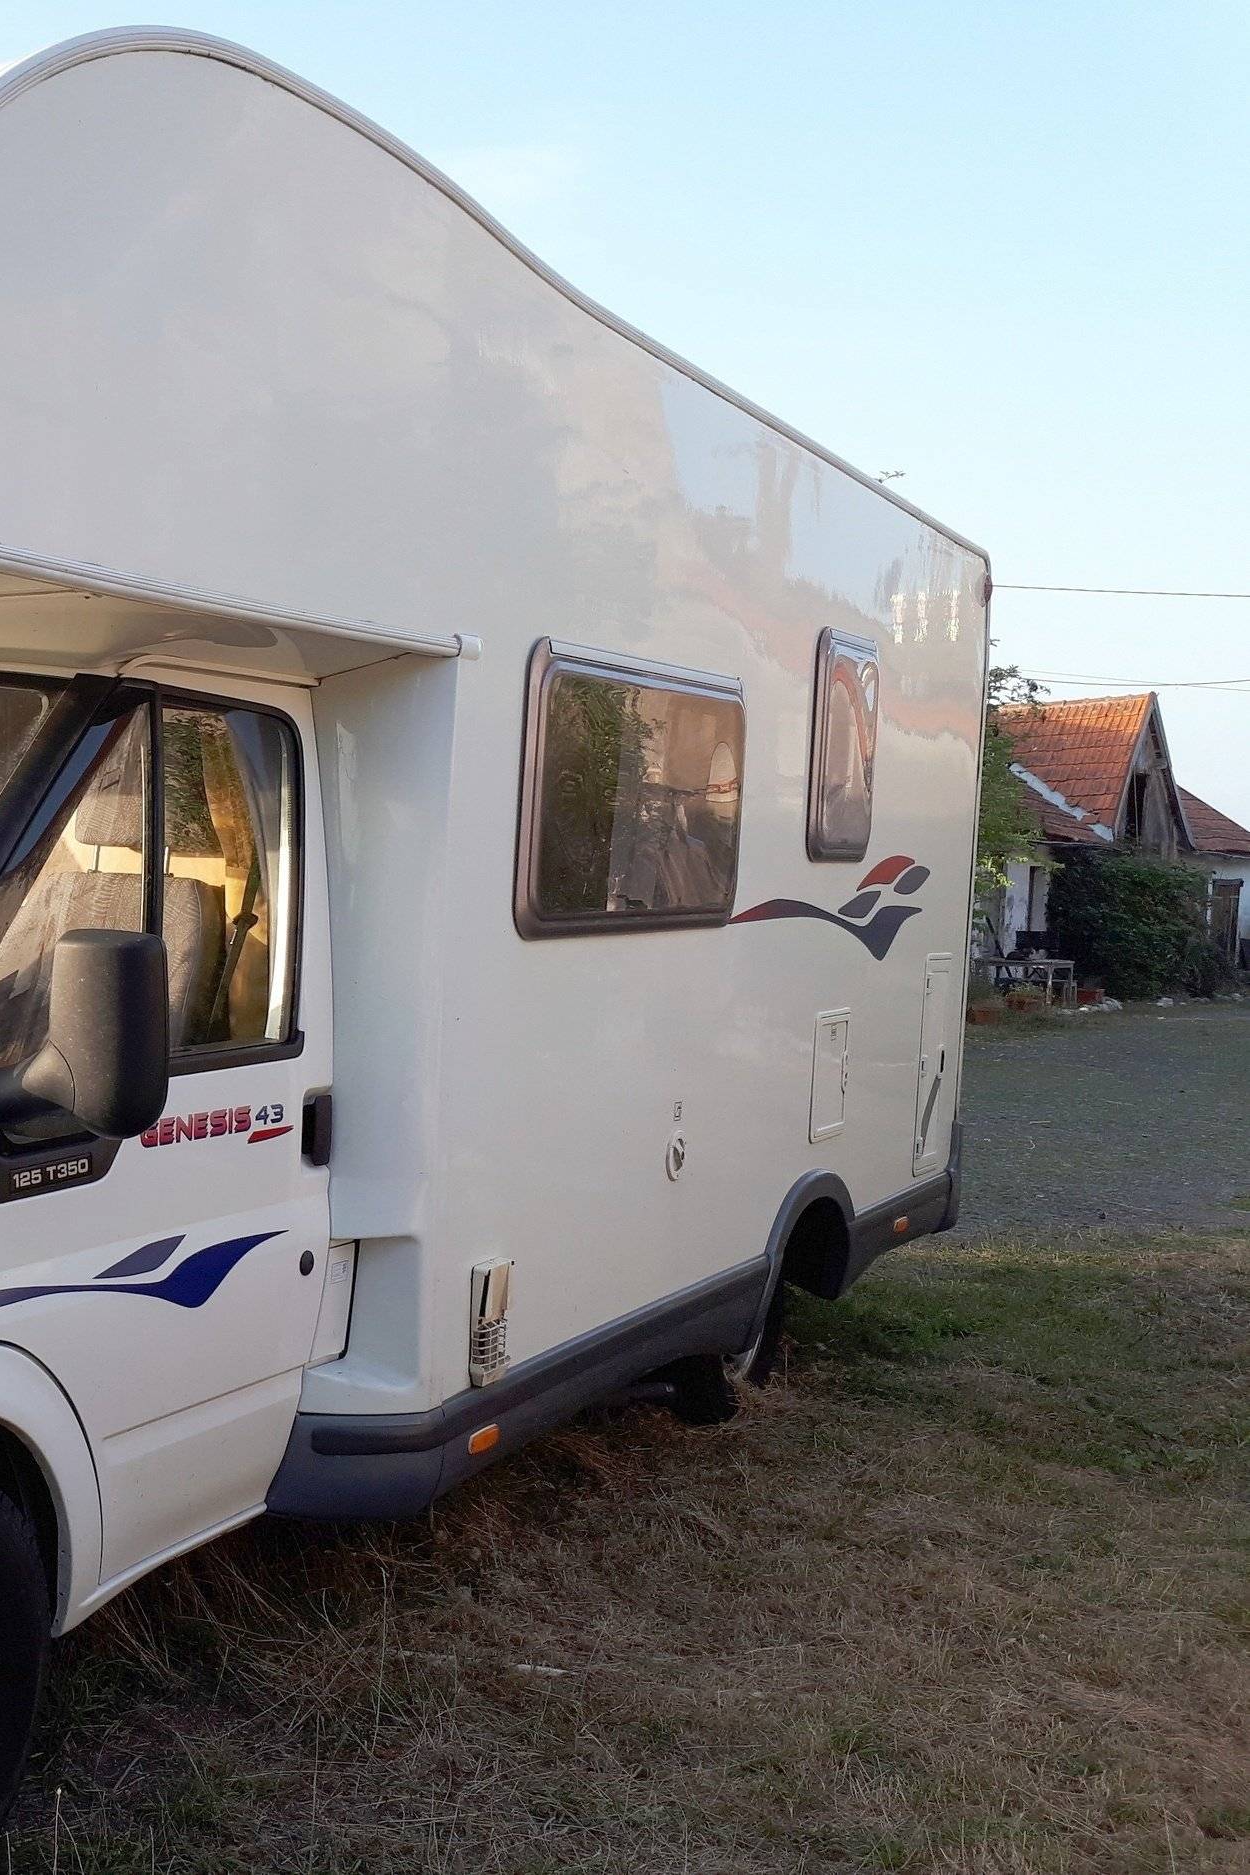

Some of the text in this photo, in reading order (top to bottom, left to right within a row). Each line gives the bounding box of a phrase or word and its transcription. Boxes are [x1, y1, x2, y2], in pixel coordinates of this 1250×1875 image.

[140, 1103, 284, 1148] GENESIS 43
[12, 1158, 89, 1189] 125 T350
